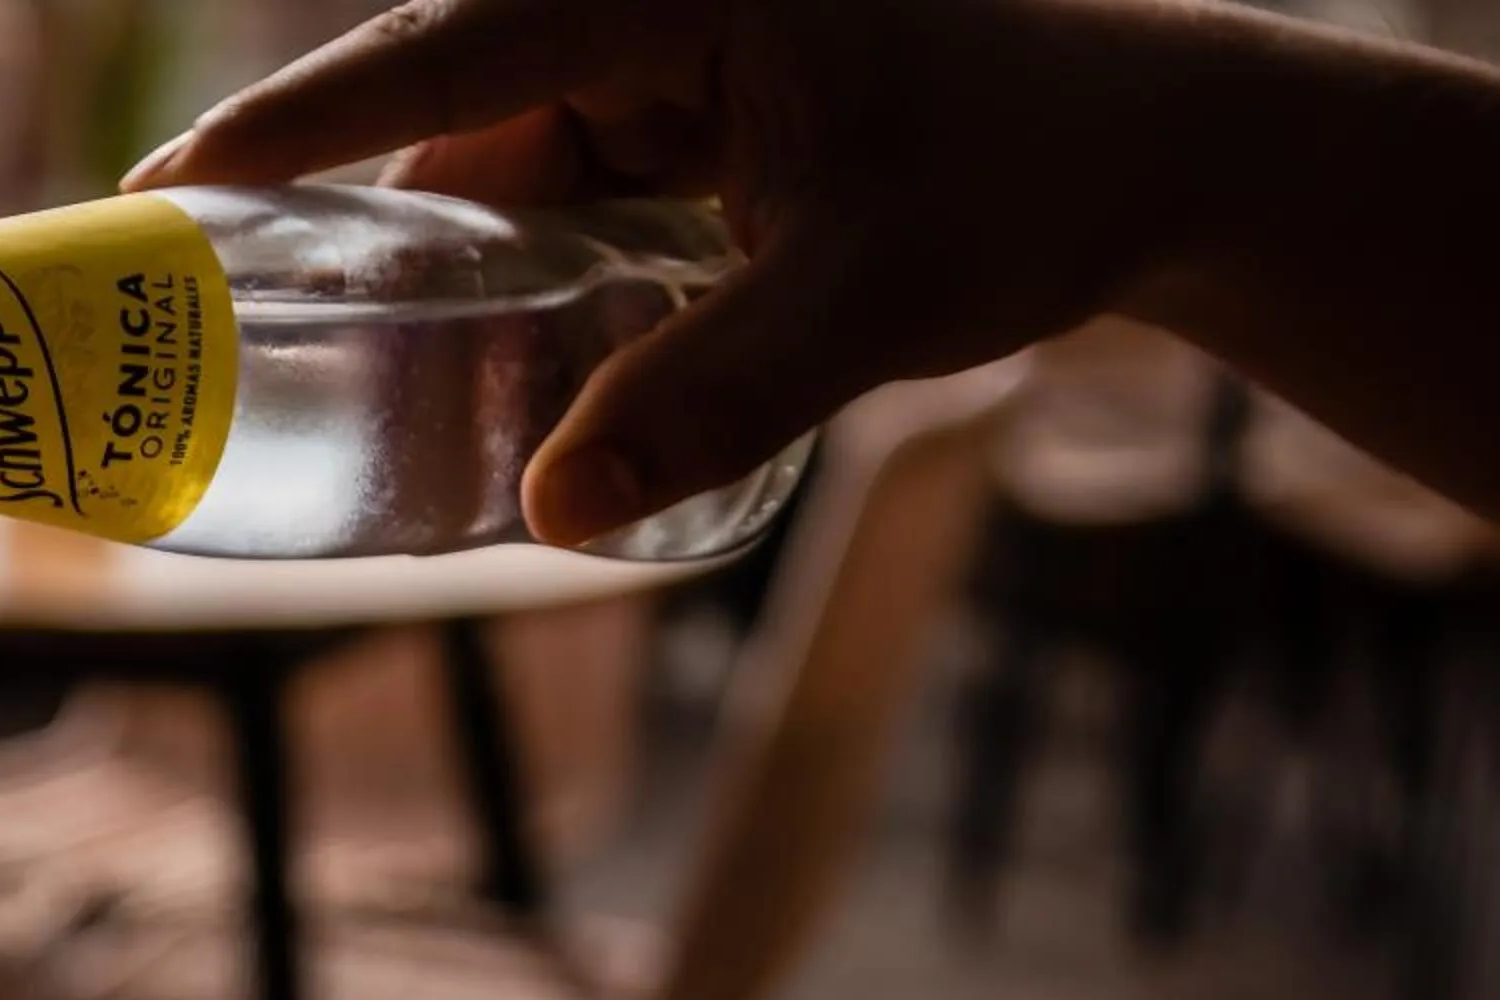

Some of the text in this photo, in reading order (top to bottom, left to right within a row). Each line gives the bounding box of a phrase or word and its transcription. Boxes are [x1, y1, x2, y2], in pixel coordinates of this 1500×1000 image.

[100, 273, 151, 468] TÓNICA
[140, 273, 177, 459] ORIGINAL
[170, 275, 203, 465] 100% AROMAS NATURALES
